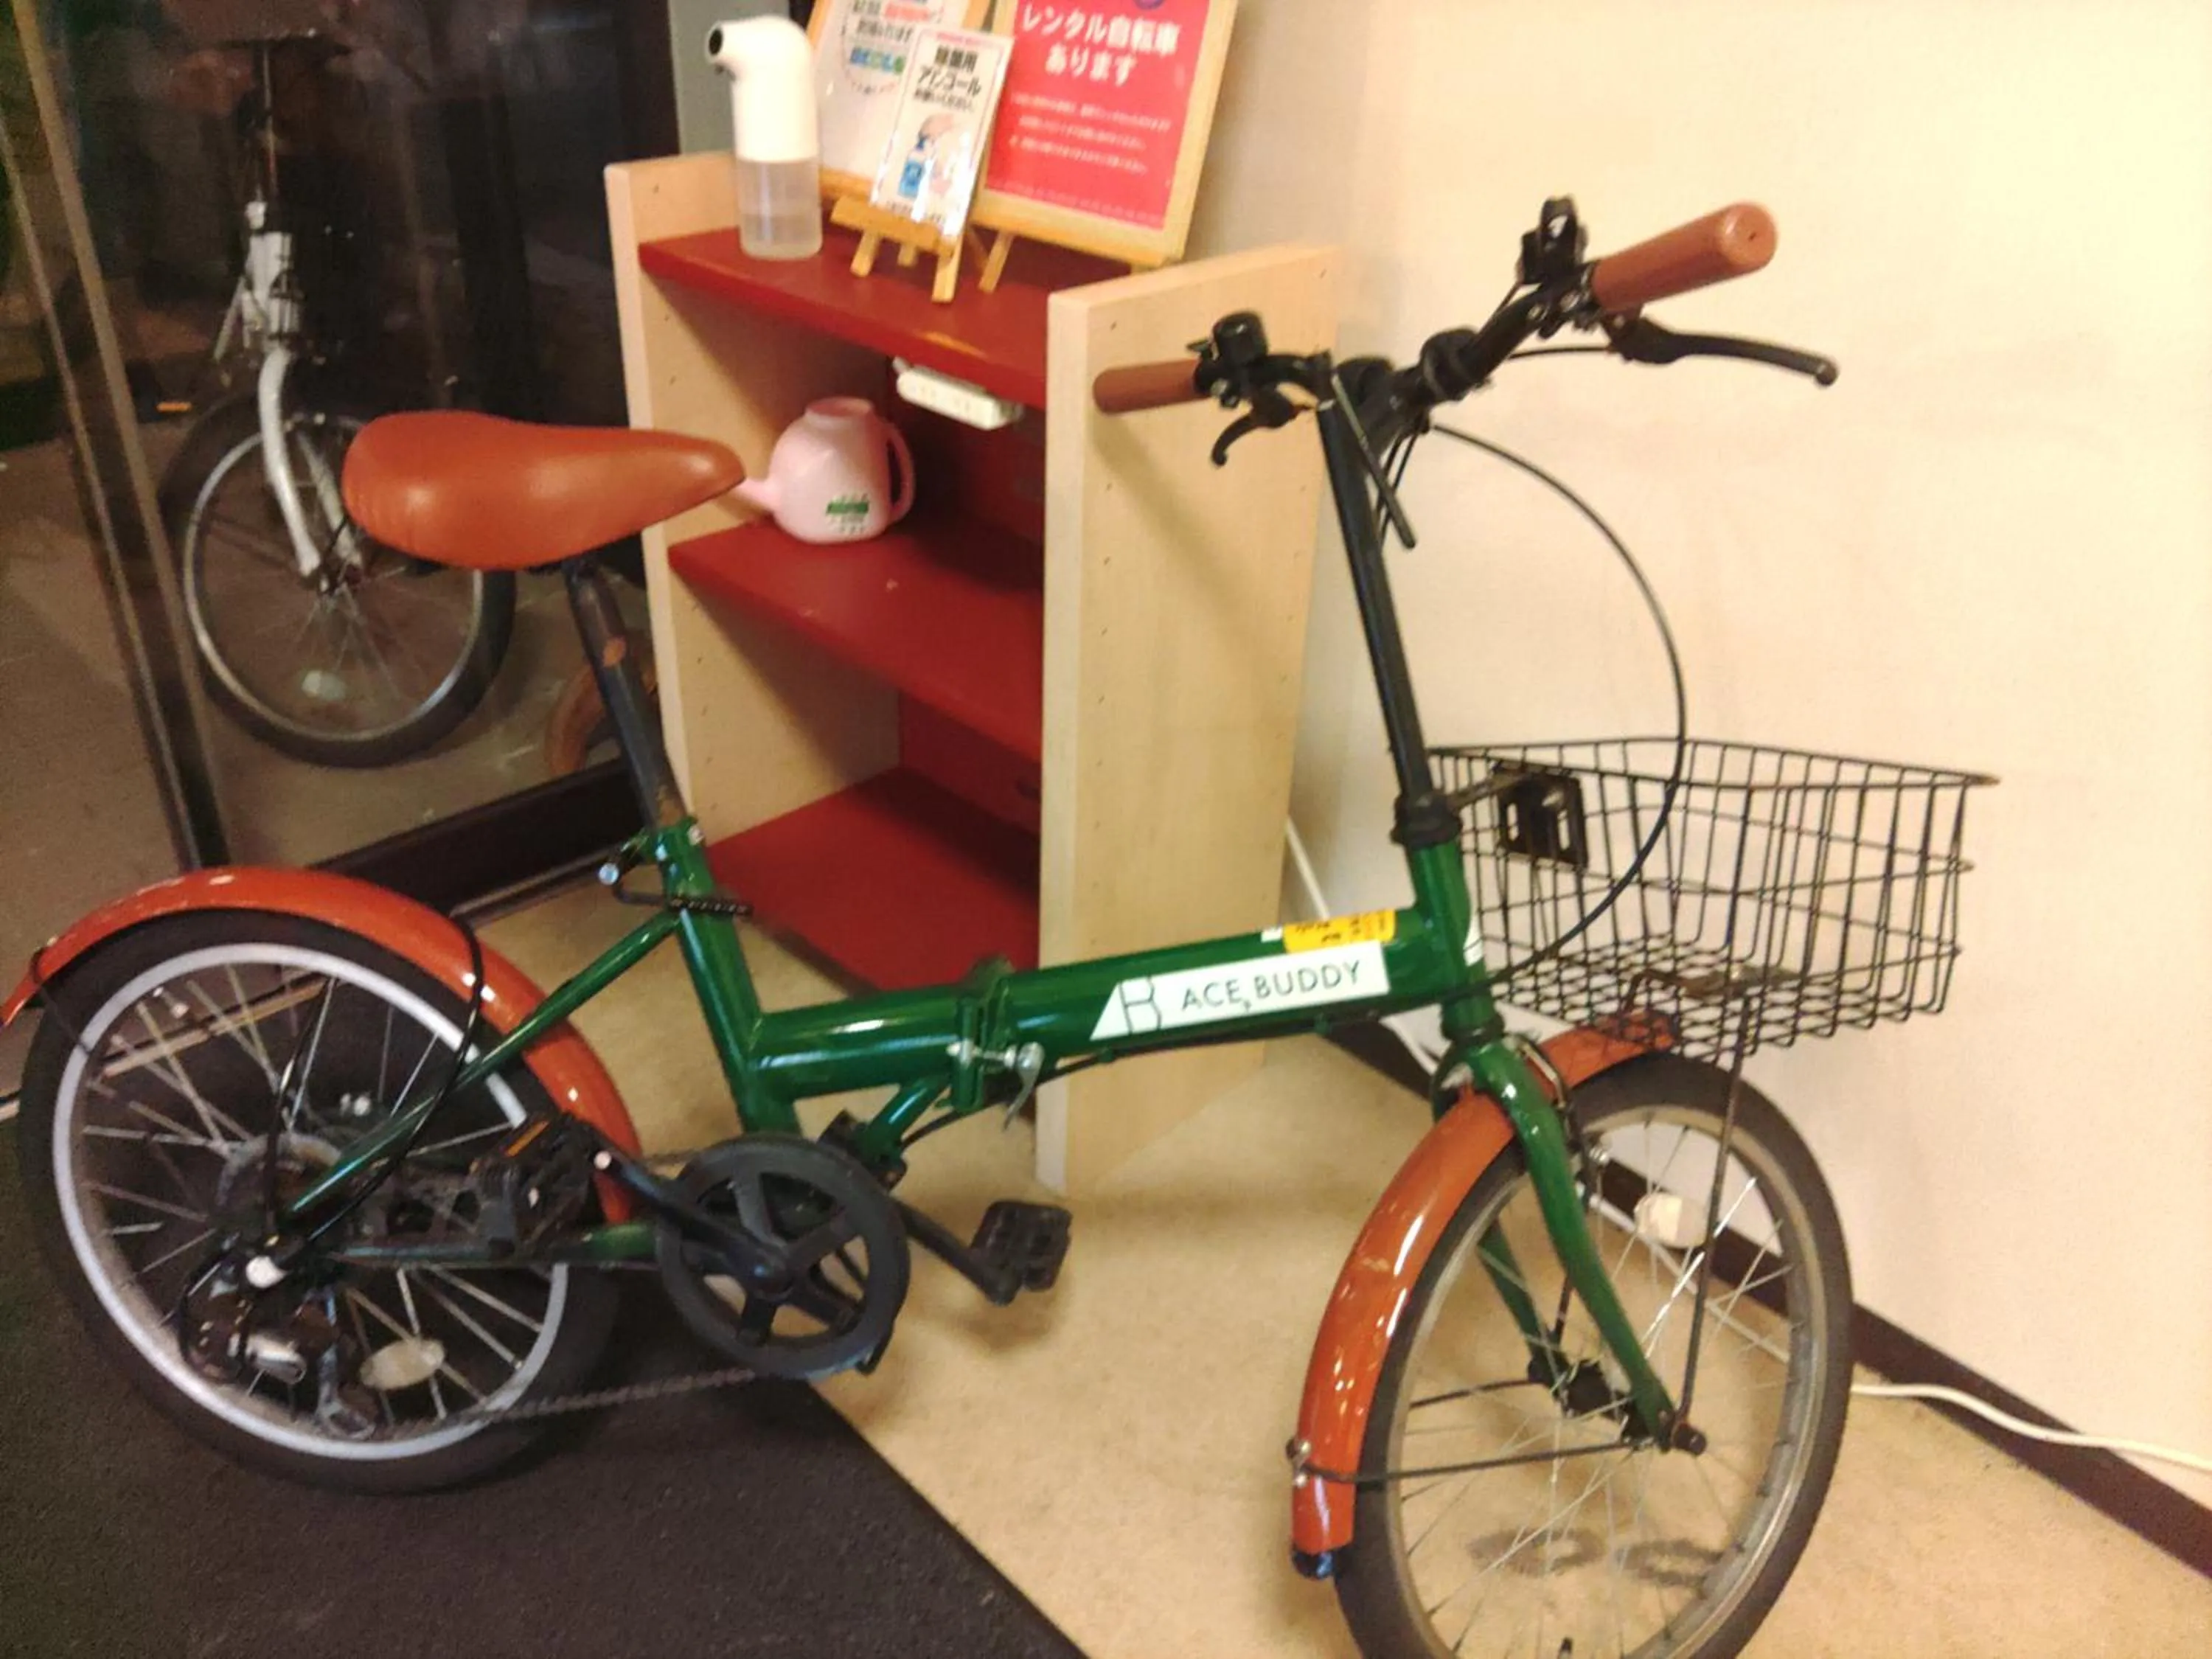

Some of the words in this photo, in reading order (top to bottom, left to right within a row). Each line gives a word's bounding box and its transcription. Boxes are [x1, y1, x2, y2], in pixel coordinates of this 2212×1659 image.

[1022, 3, 1181, 56] レンタル自転車
[1045, 43, 1137, 87] あります
